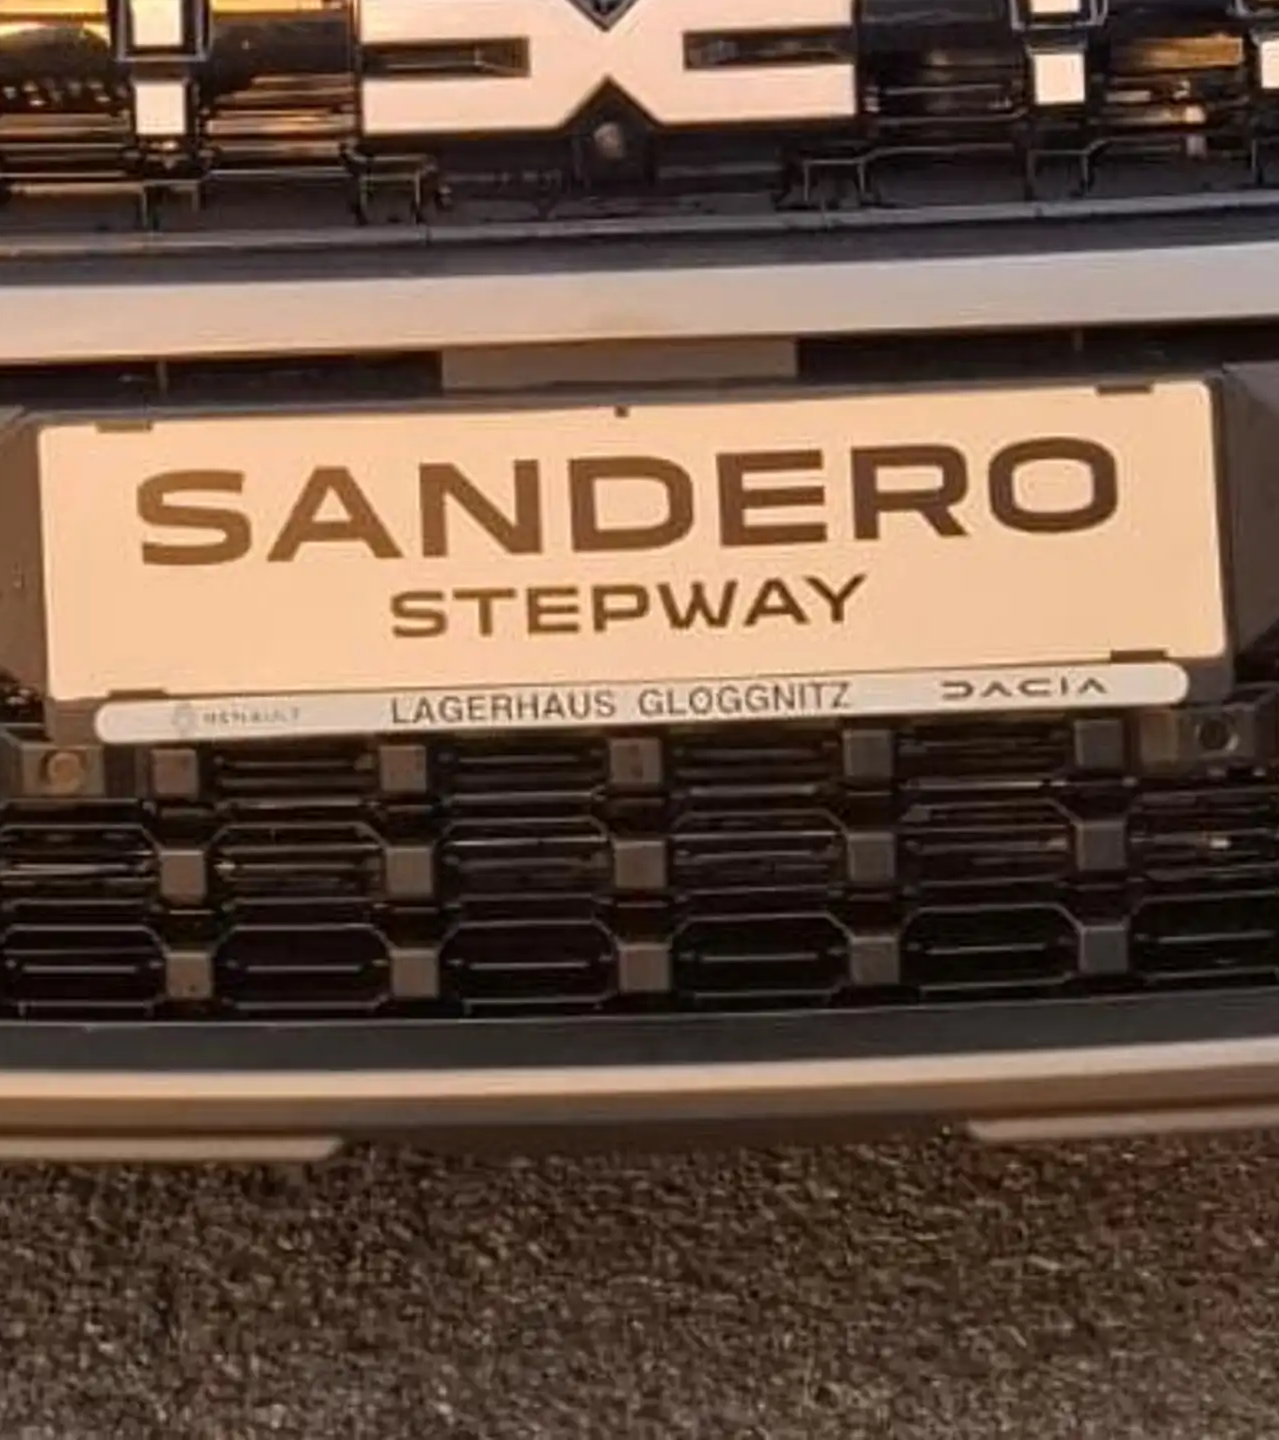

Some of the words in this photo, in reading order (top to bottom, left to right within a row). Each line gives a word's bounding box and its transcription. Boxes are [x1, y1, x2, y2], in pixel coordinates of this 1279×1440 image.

[136, 434, 1122, 567] SANDERO
[390, 574, 867, 639] STEPWAY
[391, 689, 617, 725] LAGERHAUS
[638, 680, 851, 716] GLOGGNITZ
[940, 676, 1108, 702] DACIA
